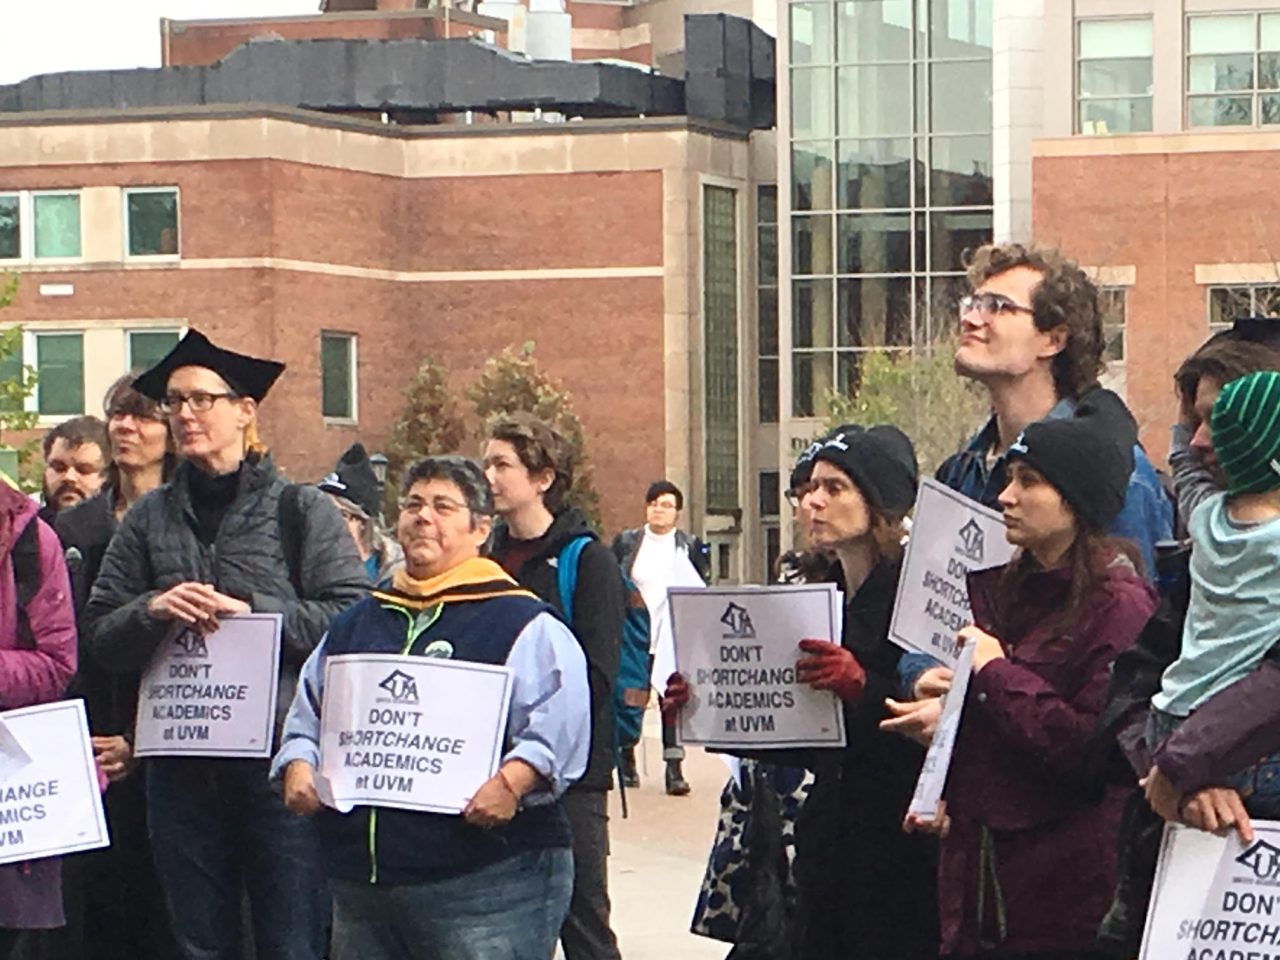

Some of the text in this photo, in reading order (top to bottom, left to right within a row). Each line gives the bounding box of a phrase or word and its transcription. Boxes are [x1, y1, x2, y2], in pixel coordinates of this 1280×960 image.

[946, 557, 972, 580] DON
[922, 570, 970, 611] SHORTCH
[924, 598, 970, 631] ACADEM
[719, 645, 764, 662] DON'T
[168, 664, 213, 679] DON'T
[152, 704, 232, 721] ACADEMICS
[368, 708, 424, 727] DON'T
[163, 725, 210, 741] at UVM
[739, 715, 776, 733] UVM
[338, 730, 466, 755] SHORTCHANGE
[343, 751, 444, 775] ACADEMICS
[355, 774, 414, 793] at UVM
